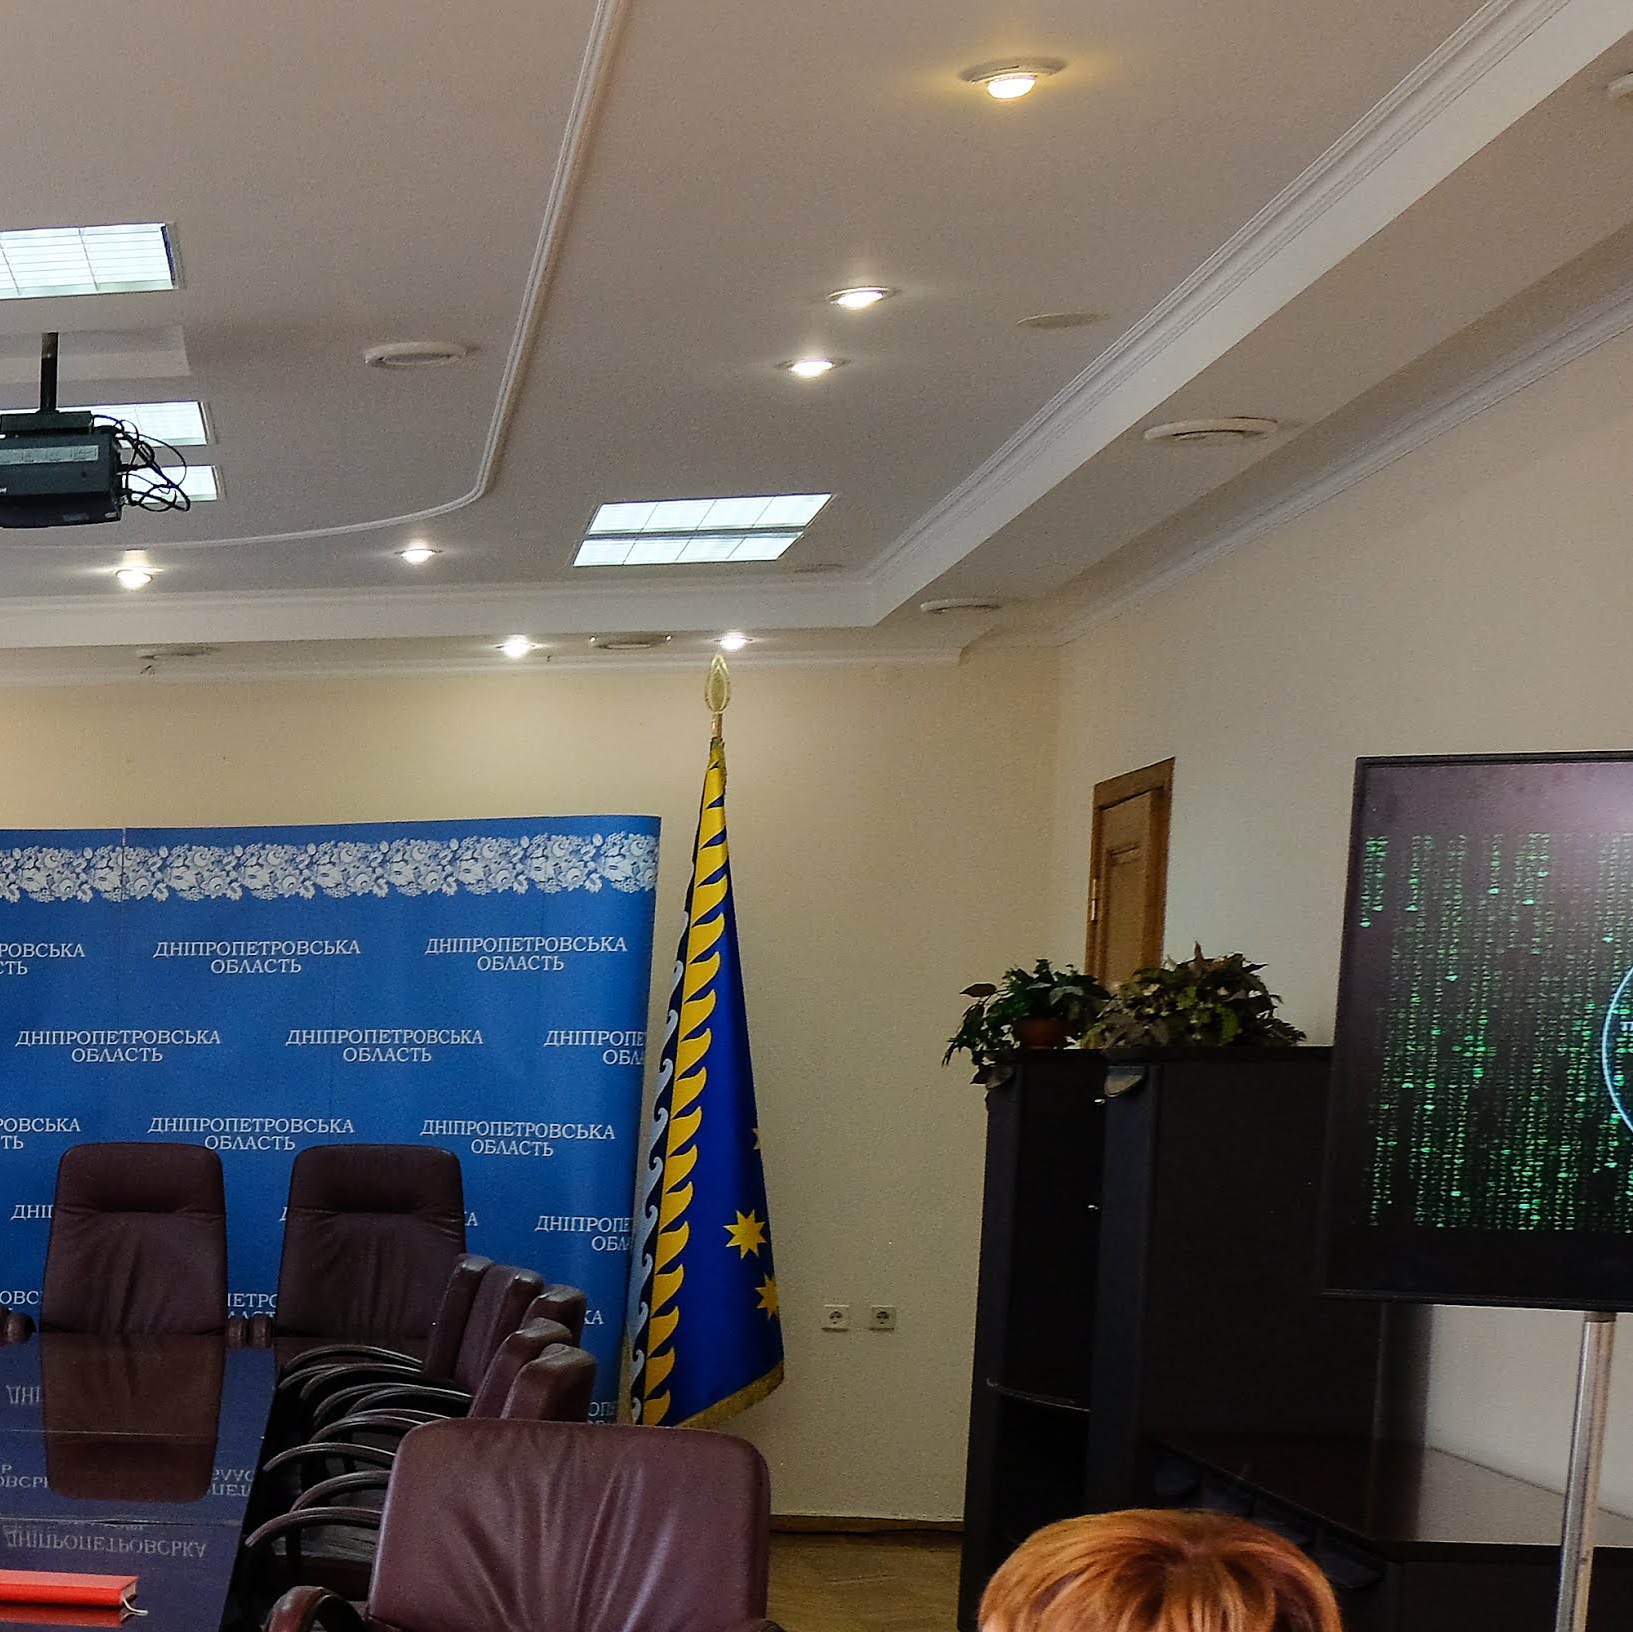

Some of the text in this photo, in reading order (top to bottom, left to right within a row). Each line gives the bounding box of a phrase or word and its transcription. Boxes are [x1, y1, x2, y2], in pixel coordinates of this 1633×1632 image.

[153, 940, 361, 959] ДНІПРОПЕТРОВСЬКА
[425, 936, 627, 955] ДНІПРОПЕТРОВСЬКА
[210, 959, 302, 974] ОБЛАСТЬ
[477, 956, 564, 971] ОБЛАСТЬ
[15, 1030, 221, 1047] ДНІПРОПЕТРОВСЬКА
[285, 1029, 484, 1047] ДНІПРОПЕТРОВСЬКА
[544, 1030, 646, 1047] ДНІПРОПЕ
[71, 1048, 163, 1062] ОБЛАСТЬ
[343, 1047, 431, 1062] ОБЛАСТЬ
[148, 1117, 354, 1134] ДНІПРОПЕТРОВСЬКА
[420, 1119, 615, 1139] ДНІПРОПЕТРОВСЬКА
[204, 1135, 296, 1151] ОБЛАСТЬ
[471, 1138, 554, 1157] ОБЛАСТЬ
[535, 1215, 630, 1232] ДНІПРОПЕ
